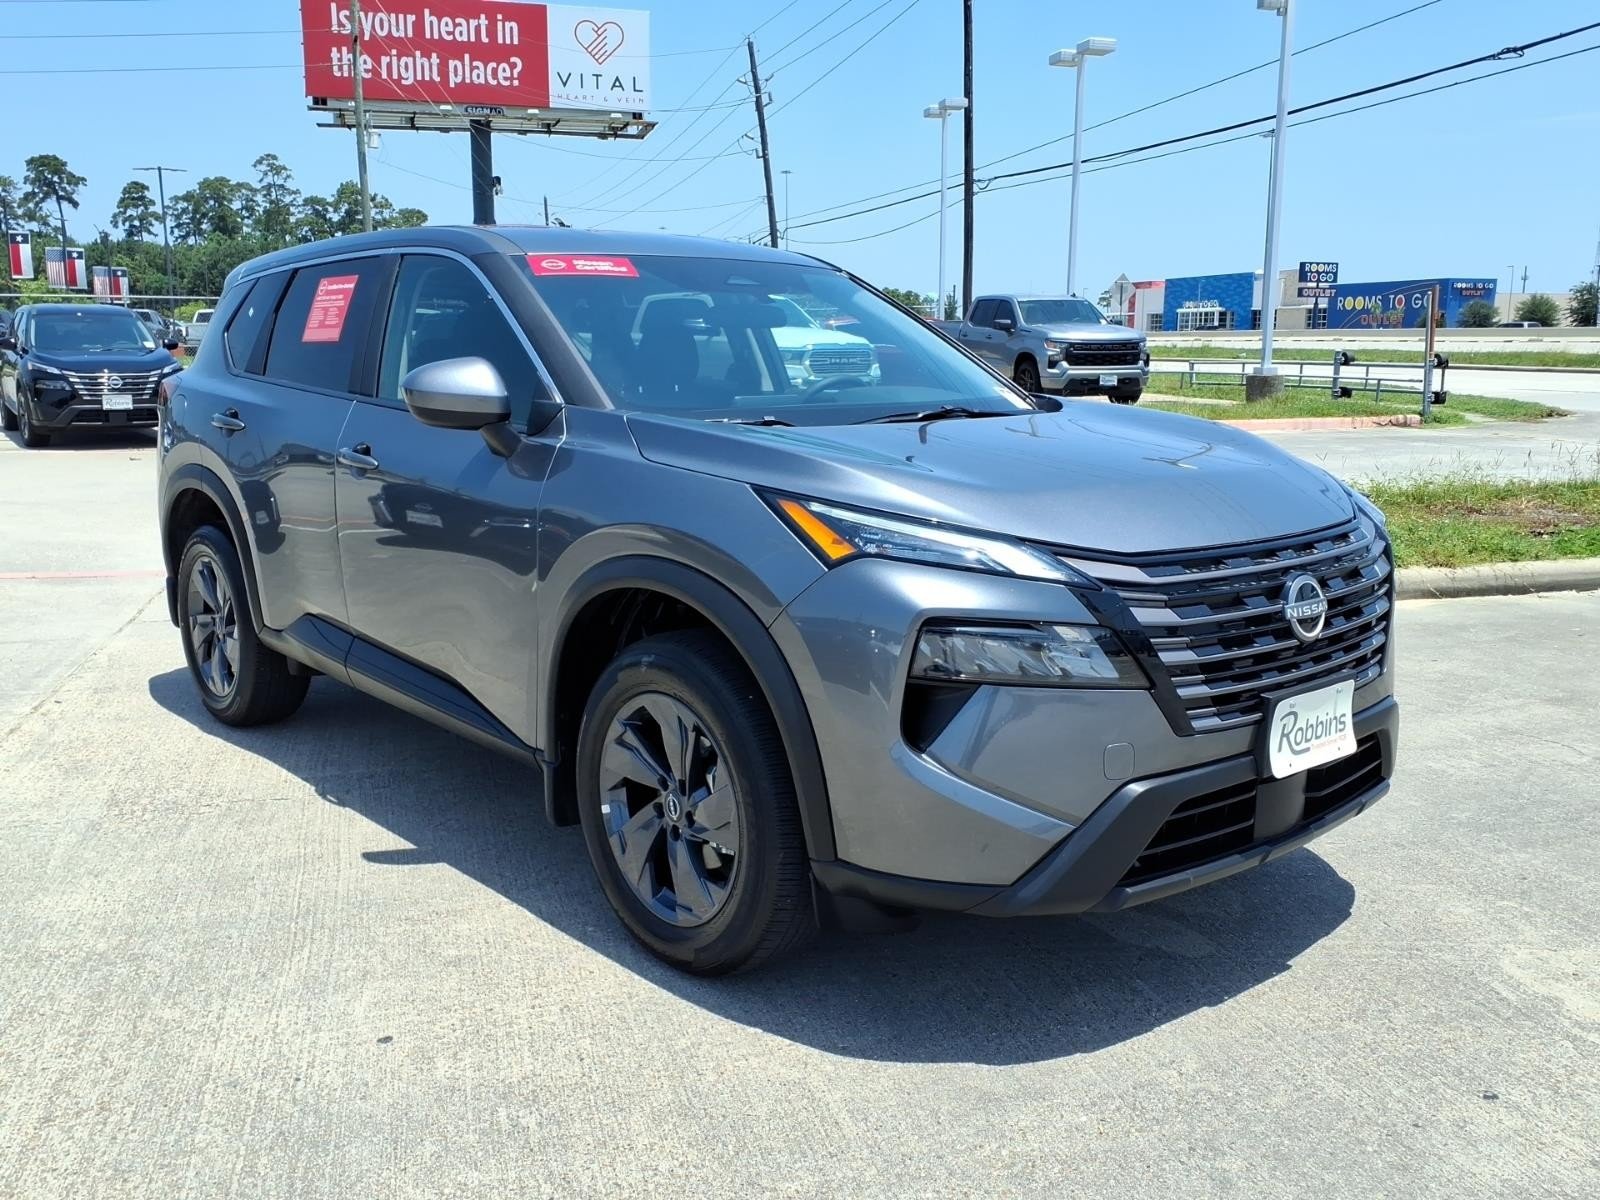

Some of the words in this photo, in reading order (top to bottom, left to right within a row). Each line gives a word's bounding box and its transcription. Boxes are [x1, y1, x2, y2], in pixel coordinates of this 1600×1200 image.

[331, 2, 352, 34] Is
[359, 11, 416, 40] your
[424, 8, 489, 43] heart
[497, 13, 519, 45] in
[331, 46, 372, 79] the
[381, 49, 441, 85] right
[448, 53, 523, 88] place?
[557, 71, 644, 93] VITAL
[557, 93, 595, 101] HEART
[1305, 263, 1337, 273] ROOMS
[1307, 272, 1318, 282] TO
[1320, 272, 1334, 282] GO
[1302, 288, 1337, 297] OUTLET
[1337, 295, 1382, 311] ROOMS
[1388, 294, 1405, 309] TO
[1287, 601, 1328, 618] NISSAN
[1278, 710, 1347, 756] Robbins
